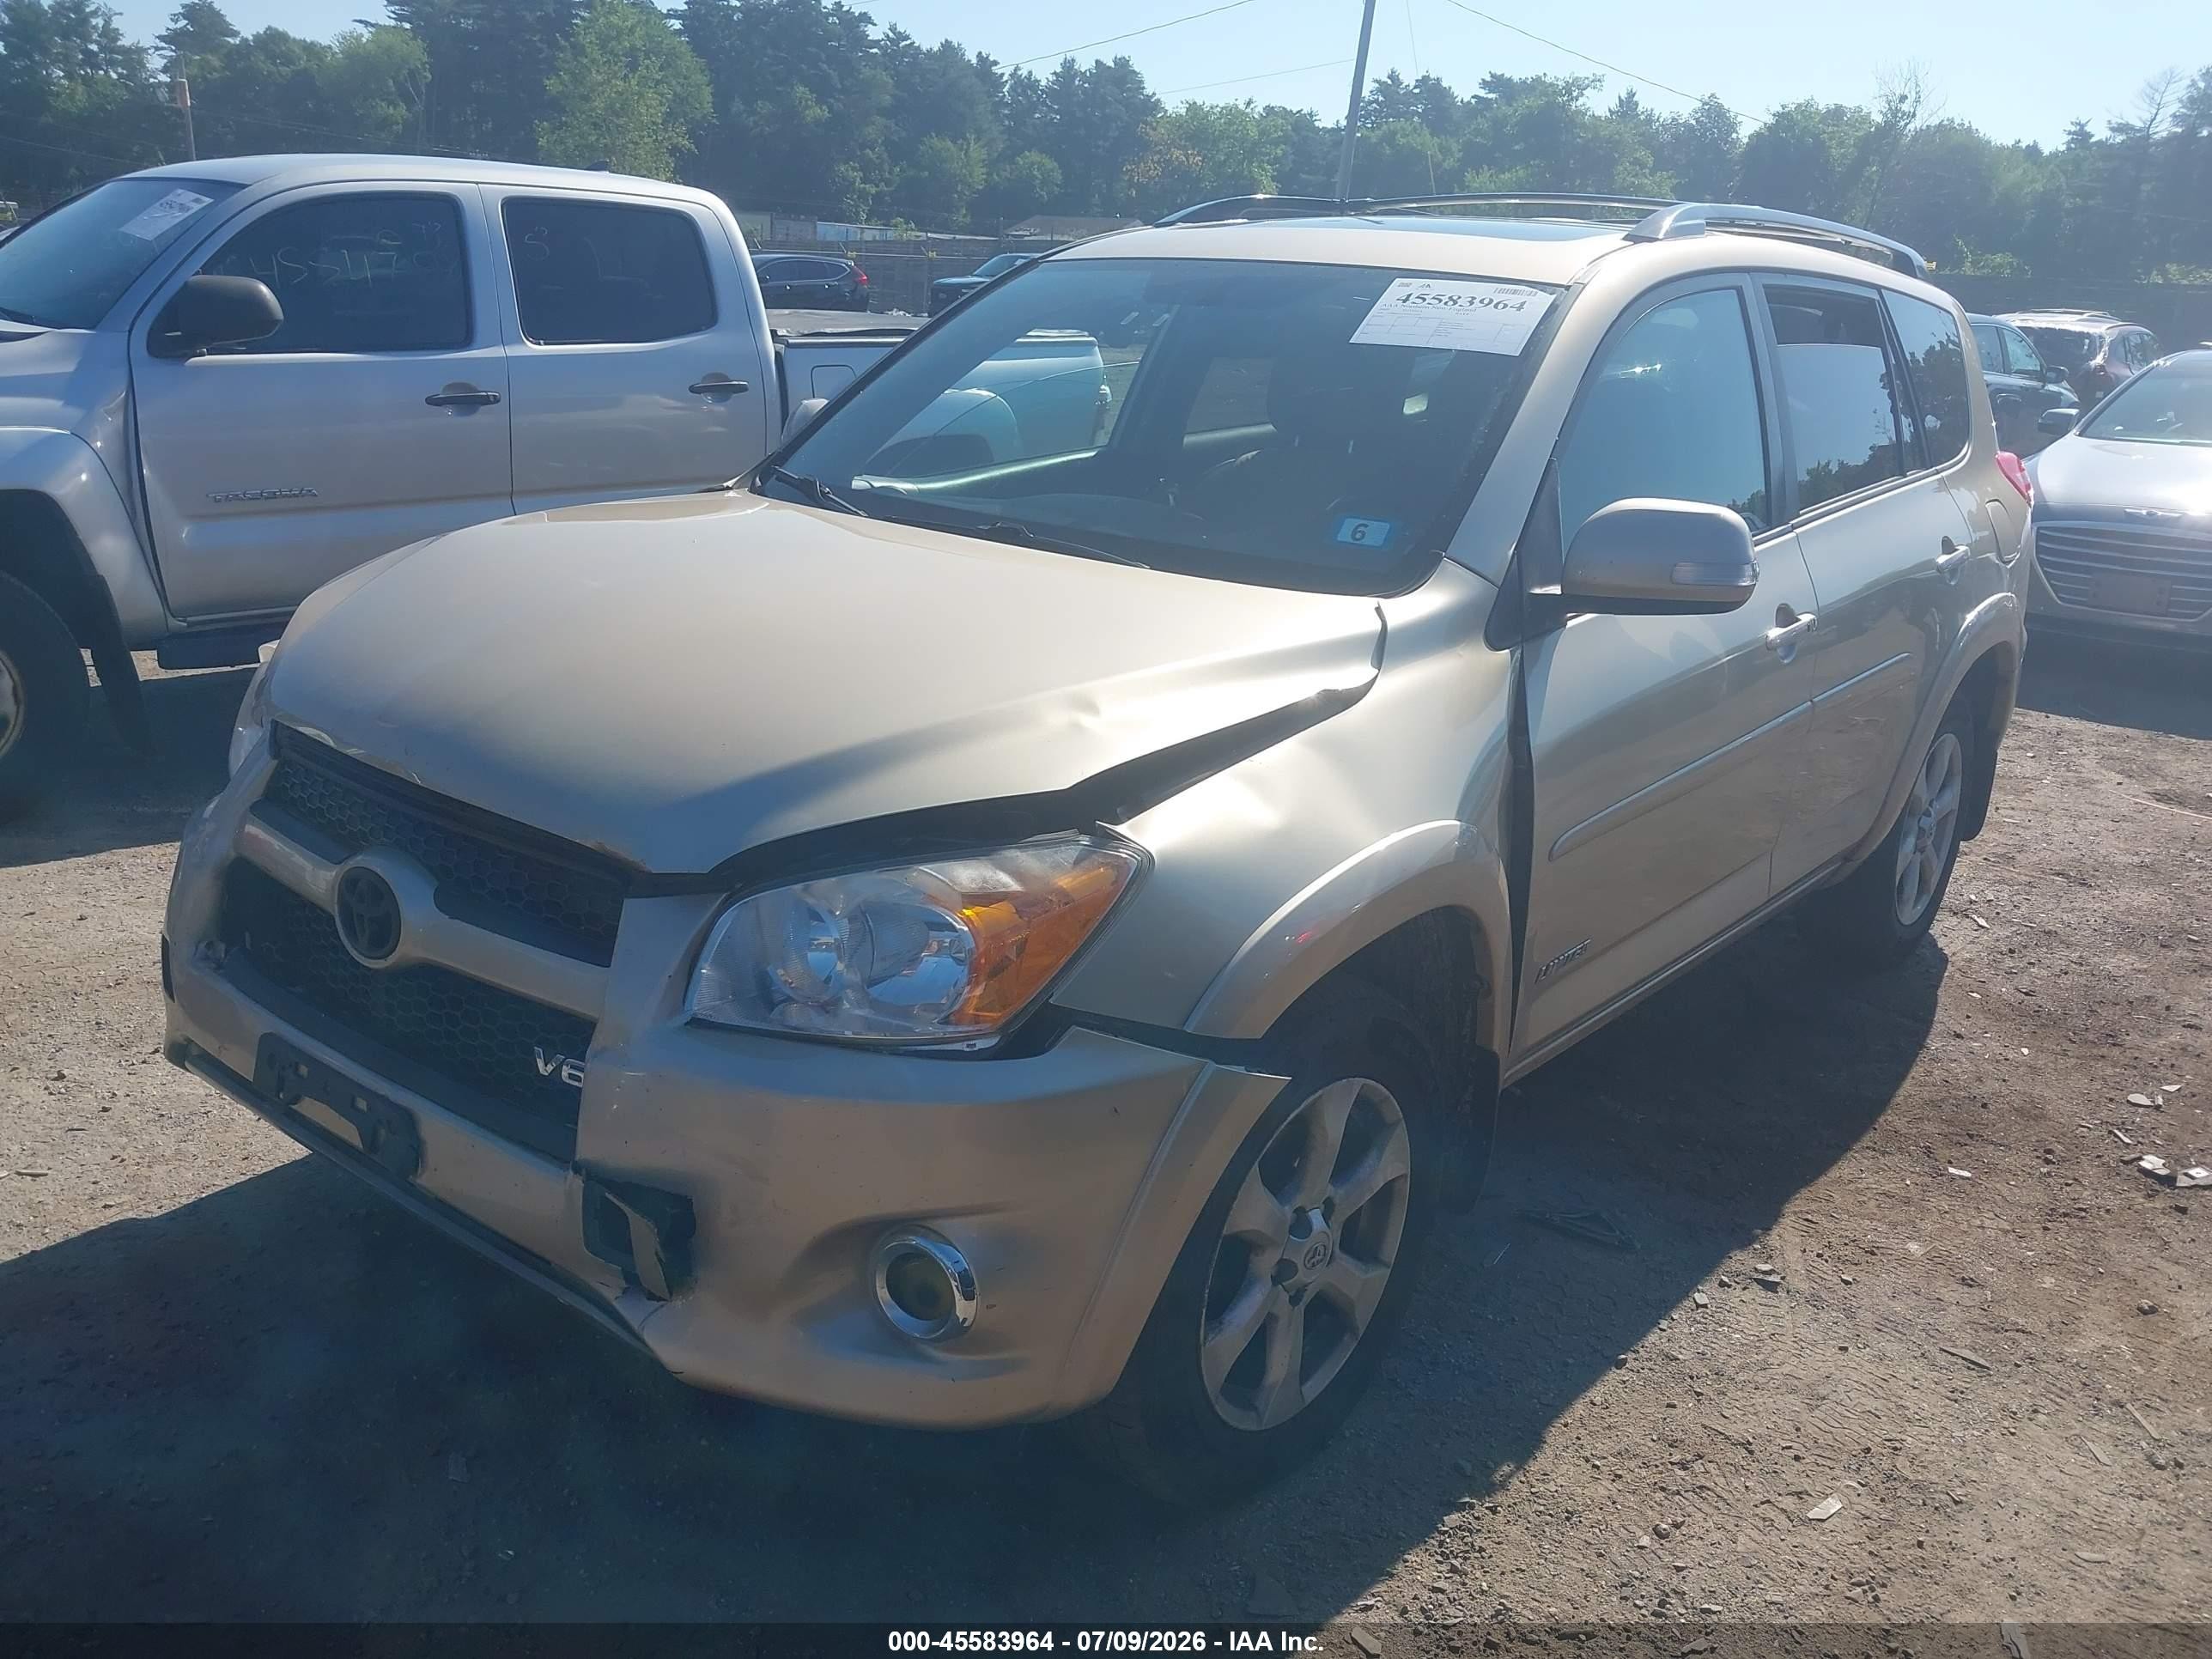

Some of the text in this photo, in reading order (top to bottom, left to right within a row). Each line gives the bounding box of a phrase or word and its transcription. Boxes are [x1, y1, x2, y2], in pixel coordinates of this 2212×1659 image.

[1395, 293, 1527, 312] 45583964
[1351, 522, 1370, 542] 6
[533, 1046, 586, 1088] V6
